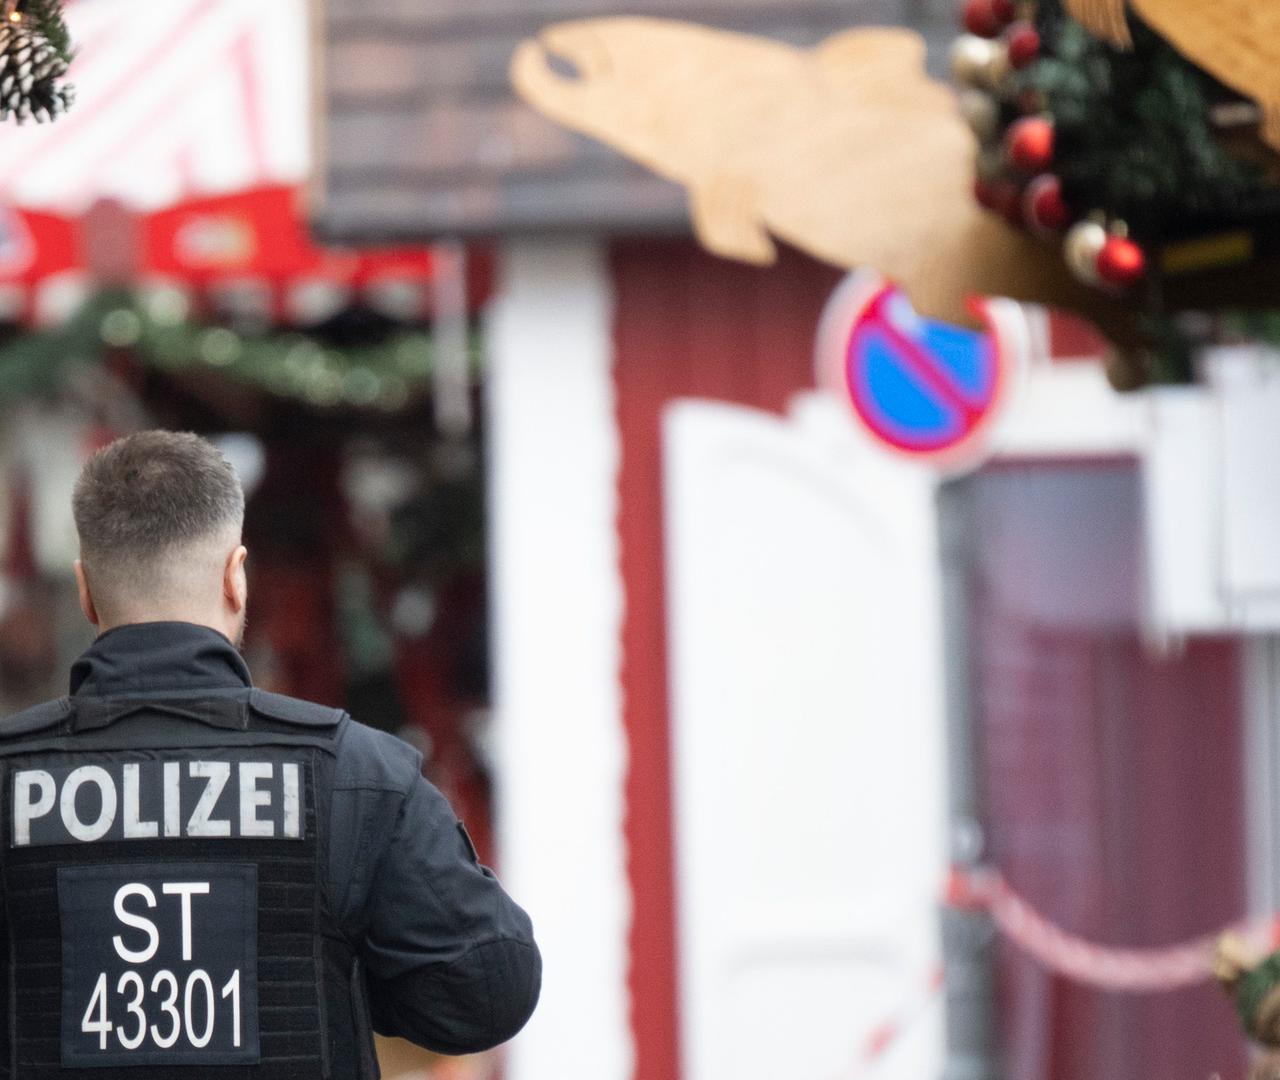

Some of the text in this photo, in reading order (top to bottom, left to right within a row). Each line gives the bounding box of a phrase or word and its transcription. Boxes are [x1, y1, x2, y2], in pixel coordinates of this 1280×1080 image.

[12, 759, 301, 845] POLIZEI
[112, 881, 210, 963] ST
[81, 967, 242, 1050] 43301
